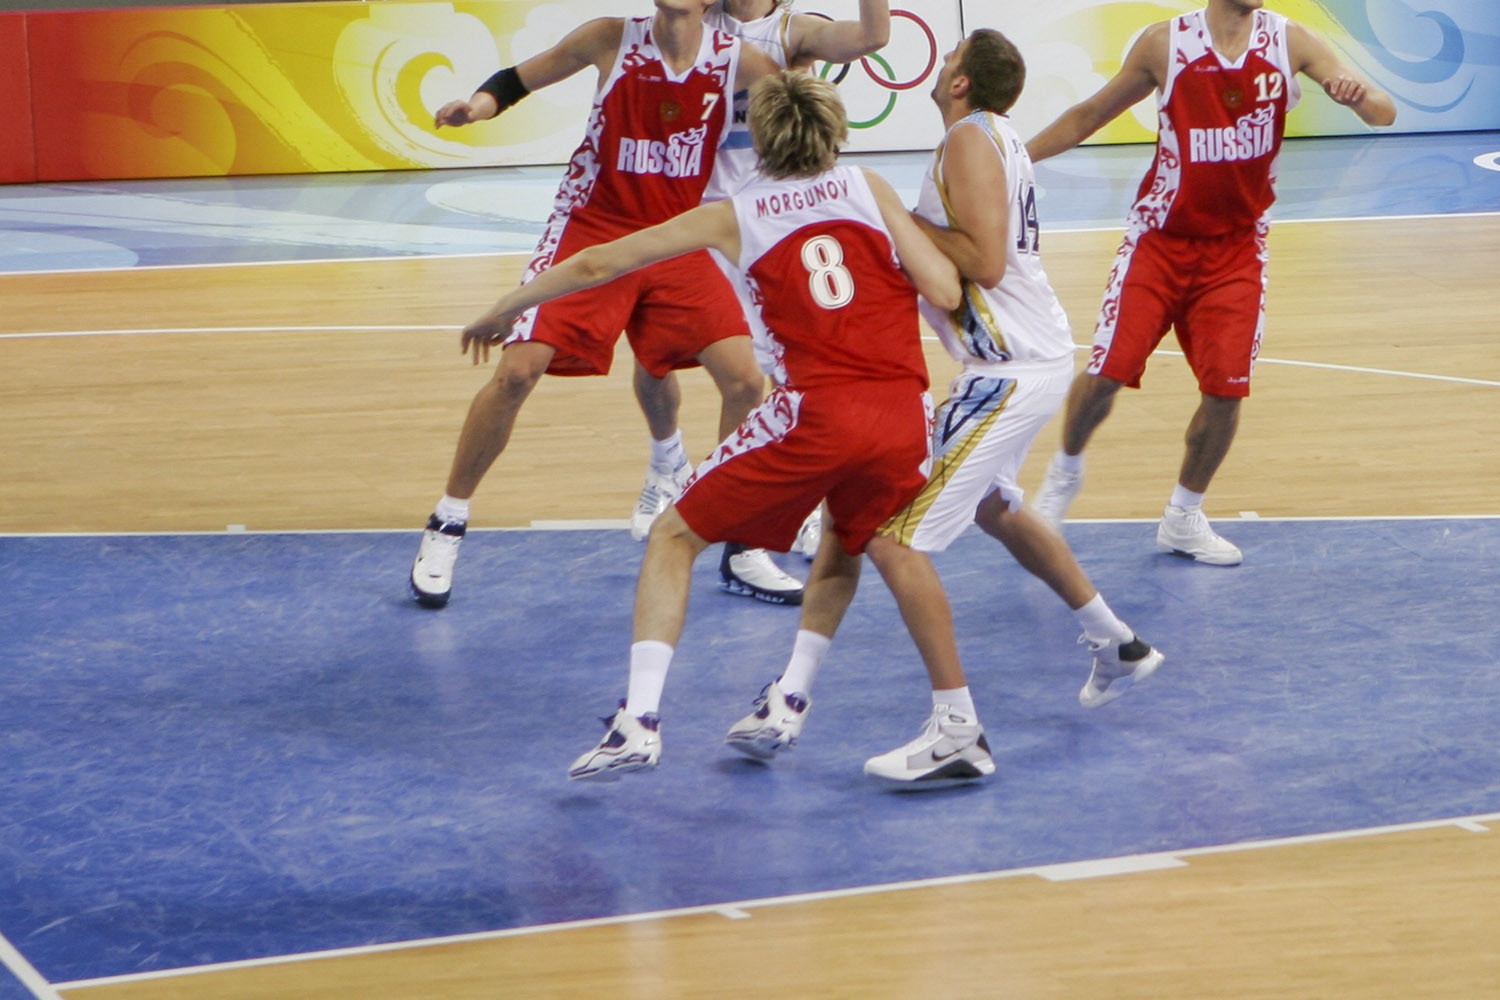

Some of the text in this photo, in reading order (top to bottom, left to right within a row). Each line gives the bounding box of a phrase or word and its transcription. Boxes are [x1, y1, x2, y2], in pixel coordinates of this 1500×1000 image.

[700, 92, 720, 121] 7
[1254, 71, 1283, 102] 12
[616, 135, 704, 178] RUSSIA
[1189, 122, 1274, 163] RUSSIA
[756, 179, 849, 218] MORGUNOV
[801, 234, 854, 310] 8
